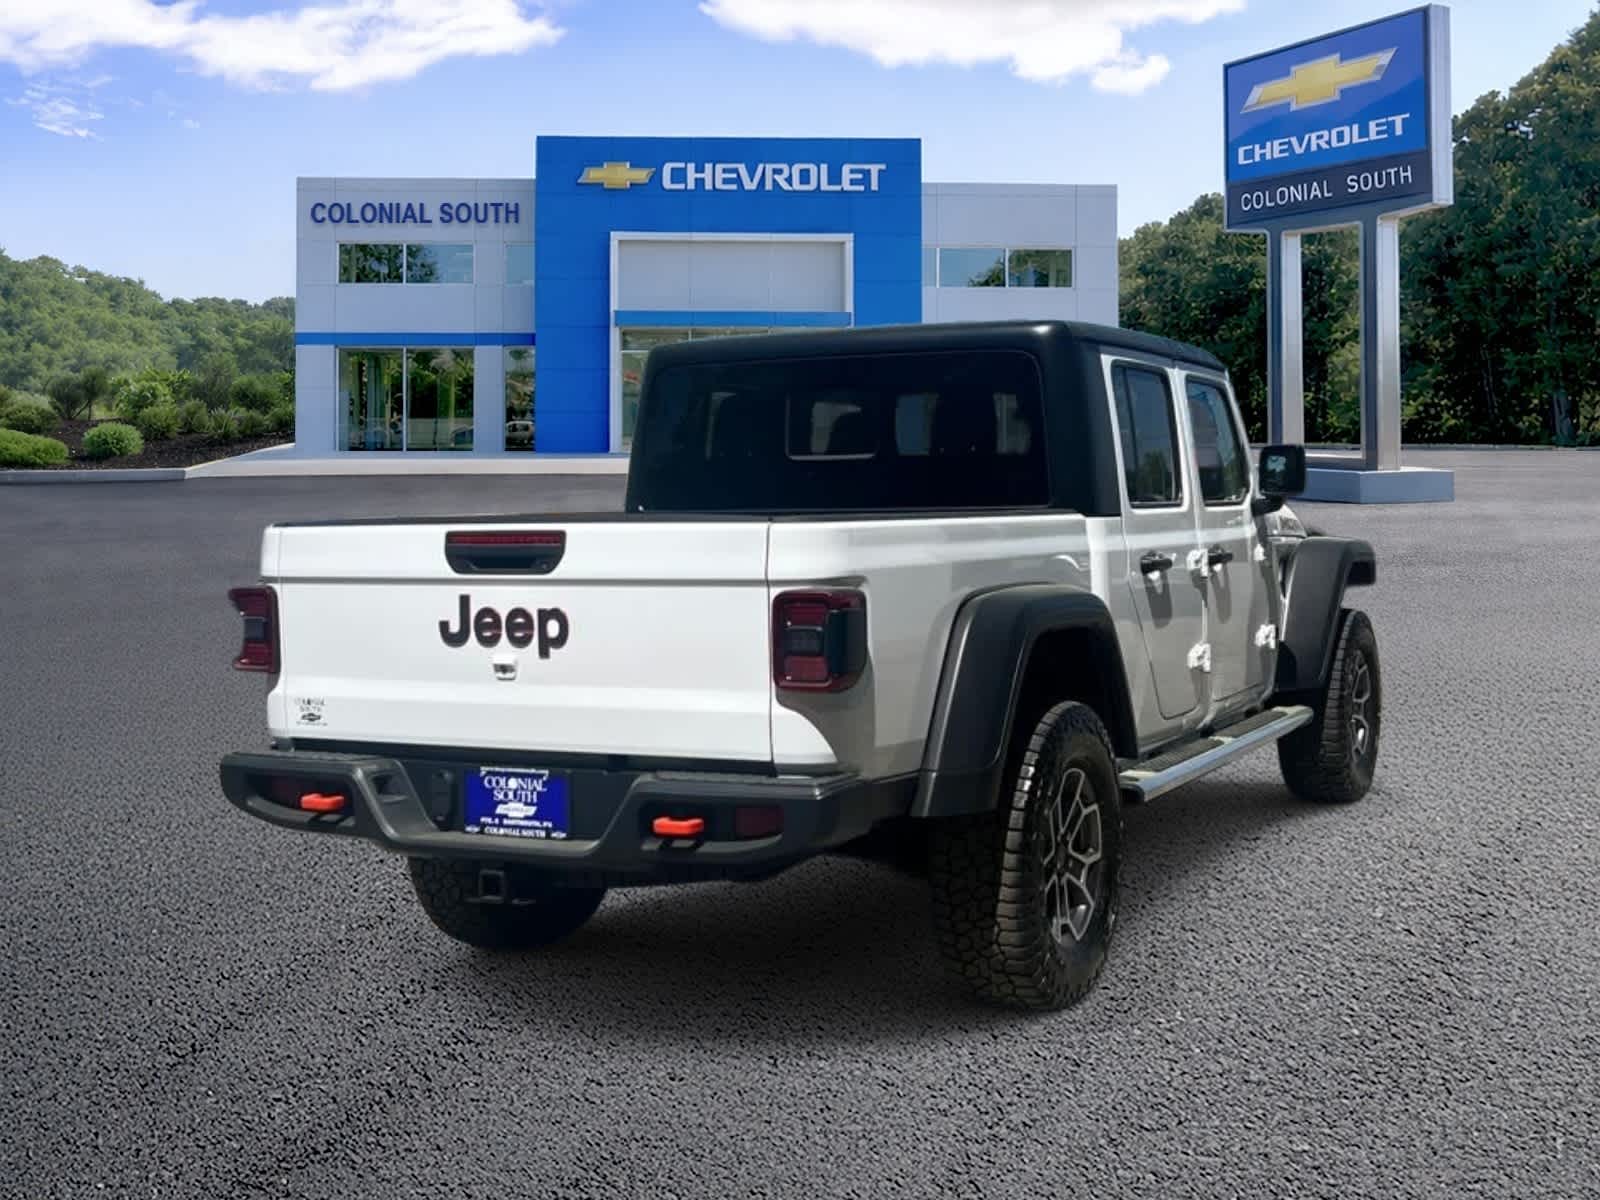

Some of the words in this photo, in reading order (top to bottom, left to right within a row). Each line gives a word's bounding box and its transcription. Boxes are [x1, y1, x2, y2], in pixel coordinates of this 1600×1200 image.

[1237, 113, 1411, 166] CHEVROLET
[662, 161, 887, 192] CHEVROLET
[1240, 180, 1334, 211] COLONIAL
[1346, 164, 1413, 194] SOUTH
[310, 202, 433, 224] COLONIAL
[439, 202, 520, 224] SOUTH
[438, 593, 570, 660] Jeep
[483, 775, 548, 792] COLONIAL
[493, 789, 538, 803] SOUTH
